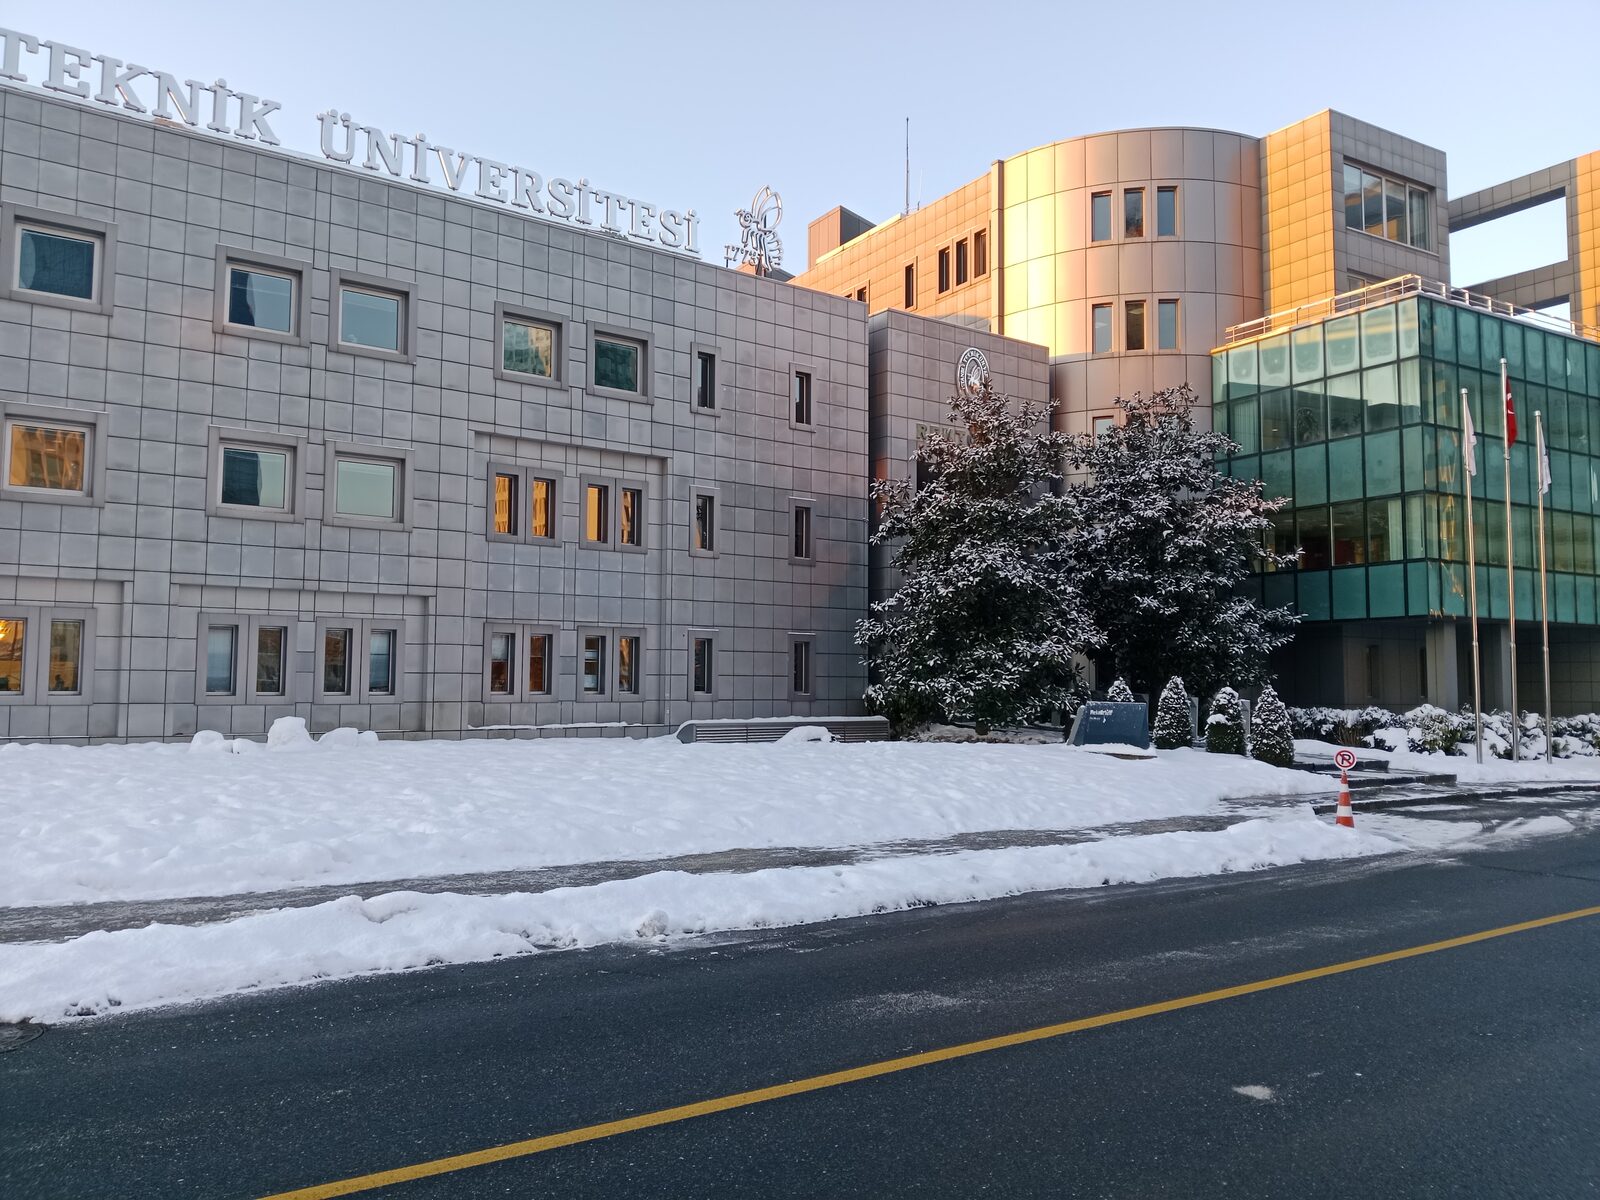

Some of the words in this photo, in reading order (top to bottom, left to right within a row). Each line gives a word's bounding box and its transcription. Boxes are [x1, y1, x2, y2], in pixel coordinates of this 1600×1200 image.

[0, 27, 282, 146] TEKNİK
[317, 108, 701, 253] ÜNİVERSİTESİ
[1341, 753, 1352, 765] P
